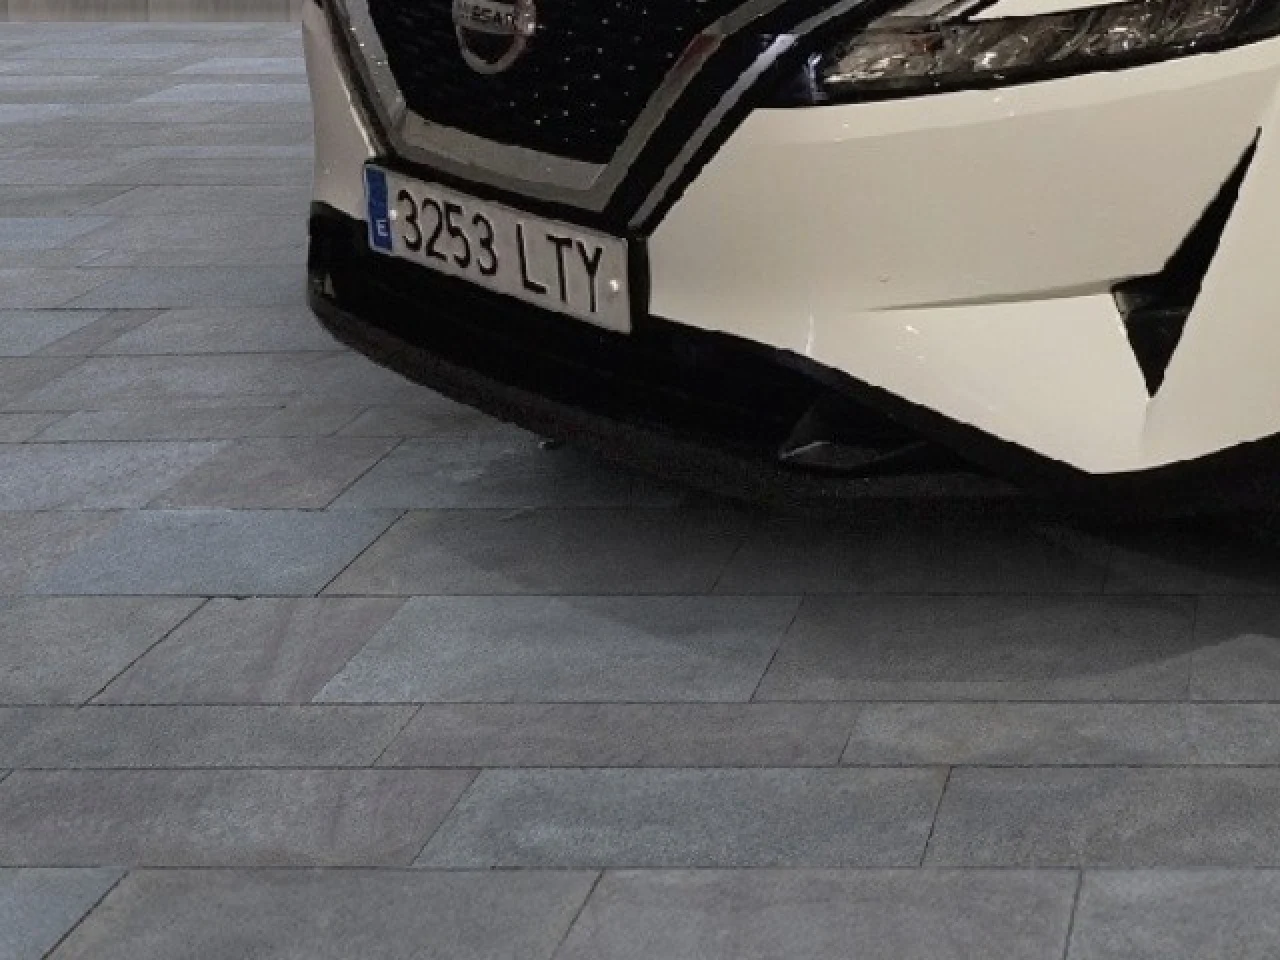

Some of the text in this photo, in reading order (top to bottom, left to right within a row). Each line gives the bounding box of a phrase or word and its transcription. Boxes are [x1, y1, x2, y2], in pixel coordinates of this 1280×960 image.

[375, 219, 389, 237] E
[397, 189, 603, 313] 3253 LTY
